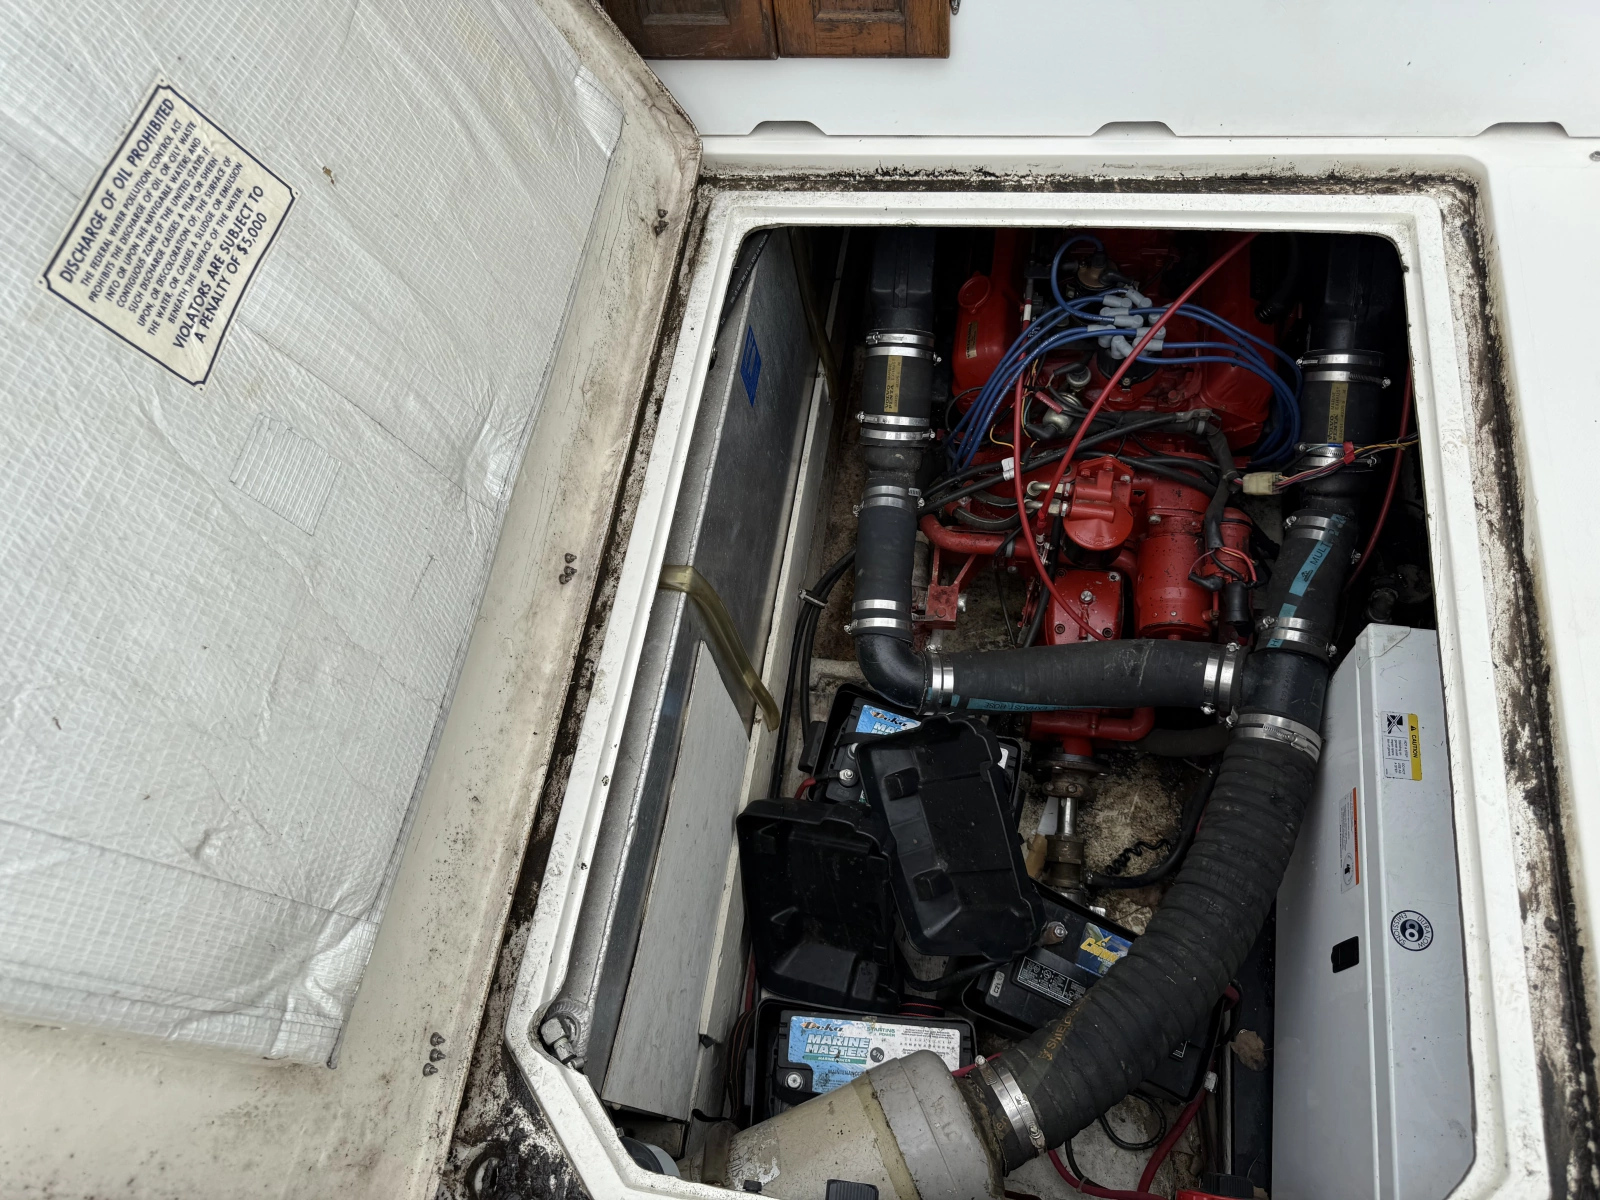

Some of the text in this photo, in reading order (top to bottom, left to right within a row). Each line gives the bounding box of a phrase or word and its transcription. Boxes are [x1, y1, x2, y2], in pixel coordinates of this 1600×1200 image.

[58, 98, 174, 283] DISCHARGE OF OIL PROHIBITED
[80, 118, 182, 286] THE FEDERAL WATER POLLUTION CONTROL ACT
[87, 260, 114, 303] PROHIBITS
[110, 244, 123, 260] THE
[119, 202, 145, 245] DISCHARGE
[142, 189, 153, 202] OF
[151, 177, 163, 190] OIL
[160, 162, 170, 175] OR
[178, 120, 196, 144] WASTE
[104, 137, 201, 301] INTO OR UPON THE NAVIGABLE WATERS AND
[116, 256, 145, 307] CONTIGUOUS
[142, 233, 158, 257] ZONE
[154, 221, 163, 233] OF
[159, 206, 173, 221] THE
[170, 178, 190, 206] UNITED
[187, 154, 204, 179] STATES
[128, 156, 218, 313] SUCH DISCHARGE CAUSES A FILM OR SHEEN
[146, 319, 160, 335] THE
[169, 276, 180, 289] OR
[176, 247, 194, 275] CAUSES
[190, 240, 198, 248] A
[194, 210, 215, 240] SLUDGE
[212, 198, 223, 210] OR
[219, 161, 243, 198] EMULSION
[150, 287, 160, 300] OR
[155, 226, 191, 287] DISCOLORATION
[194, 197, 207, 213] THE
[204, 166, 225, 199] SURFACE
[222, 155, 231, 167] OF
[167, 287, 189, 324] BENEATH
[184, 272, 196, 287] THE
[192, 239, 213, 273] SURFACE
[209, 227, 219, 239] OF
[215, 212, 229, 227] THE
[172, 185, 263, 348] VIOLATORS ARE SUBJECT TO
[193, 211, 267, 344] A PENALTY OF $5,000
[985, 701, 1007, 710] HOSE
[1411, 734, 1419, 759] CAUTION
[1080, 937, 1120, 963] CROWN
[1392, 912, 1408, 946] EMISSIONS
[1416, 915, 1431, 949] ULTRA LOW
[805, 1043, 870, 1058] MASTER
[807, 1034, 871, 1048] MARINE
[866, 1026, 896, 1034] STARTING
